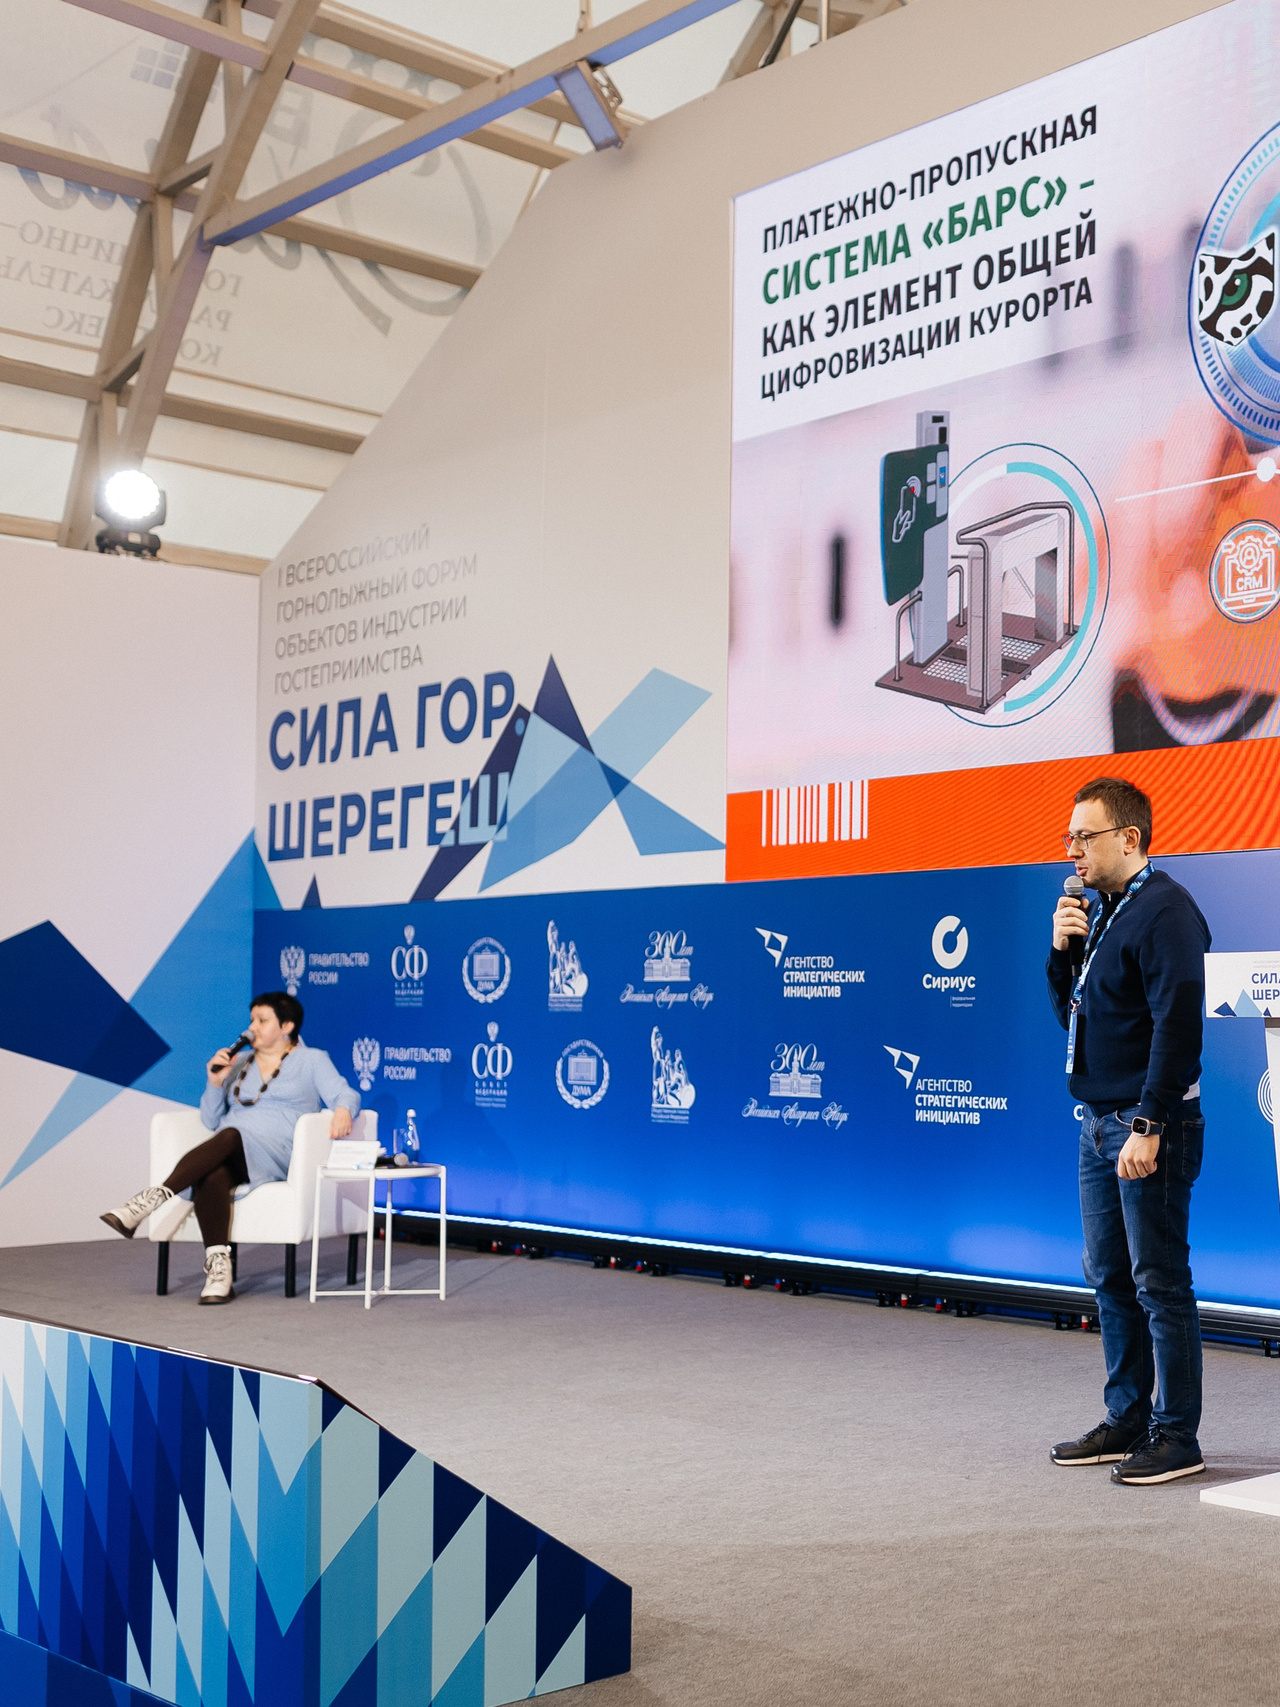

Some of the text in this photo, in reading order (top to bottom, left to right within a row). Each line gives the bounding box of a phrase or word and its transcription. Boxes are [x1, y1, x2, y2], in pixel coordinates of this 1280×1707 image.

[763, 105, 1097, 253] ПЛАТЕЖНО-ПРОПУСКНАЯ
[762, 223, 911, 304] СИСТЕМА
[922, 175, 1067, 249] «БАРС»
[762, 209, 1097, 357] КАК ЭЛЕМЕНТ ОБЩЕЙ
[761, 276, 1093, 402] ЦИФРОВИЗАЦИИ КУРОРТА
[285, 523, 430, 588] ВСЕРОССИЙСКИЙ
[276, 554, 477, 624] ГОРНОЛЫЖНЫЙ ФОРУМ
[1236, 575, 1263, 591] CRM
[275, 595, 467, 660] ОБЪЕКТОВ ИНДУСТРИИ
[274, 644, 423, 695] ГОСТЕПРИИМСТВА
[269, 671, 515, 771] СИЛА ГОР
[268, 772, 510, 862] ШЕРЕГЕШ
[391, 944, 428, 981] СФ
[783, 956, 834, 969] АГЕНТСТВО
[783, 970, 865, 983] СТРАТЕГИЧЕСКИХ
[783, 985, 842, 1000] ИНИЦИАТИВ
[922, 973, 976, 992] Сириус
[384, 1046, 452, 1063] ПРАВИТЕЛЬСТВО
[384, 1065, 416, 1080] РОССИИ
[471, 1043, 513, 1080] СФ
[916, 1078, 972, 1093] АГЕНТСТВО
[916, 1094, 1008, 1110] СТРАТЕГИЧЕСКИХ
[915, 1109, 981, 1125] ИНИЦИАТИВ
